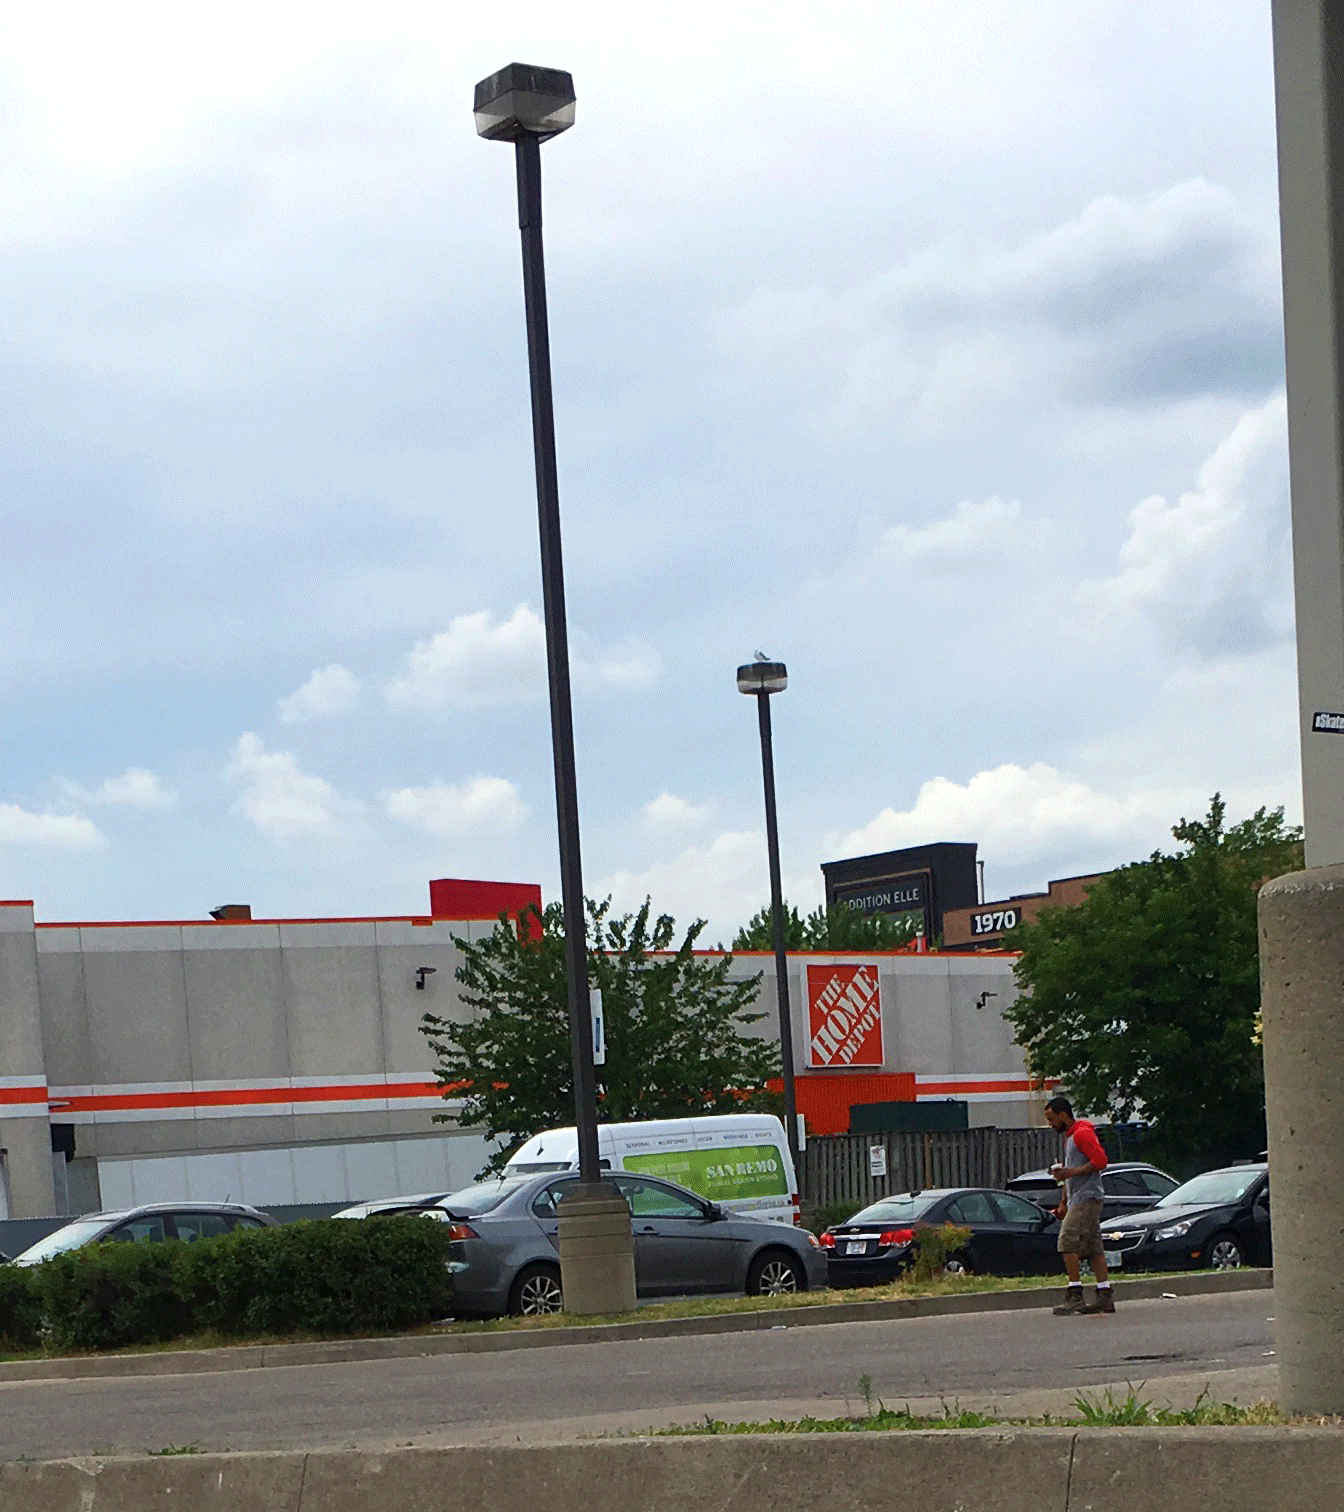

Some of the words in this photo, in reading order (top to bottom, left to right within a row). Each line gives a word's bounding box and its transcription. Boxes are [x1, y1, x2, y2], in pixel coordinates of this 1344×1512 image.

[846, 892, 891, 911] DDITION
[894, 887, 920, 904] ELLE
[974, 910, 1017, 933] 1970
[814, 974, 844, 1015] THE
[811, 966, 879, 1065] HOME
[839, 1001, 881, 1065] DEPOT
[706, 1164, 734, 1179] SAN
[736, 1159, 778, 1175] REMO
